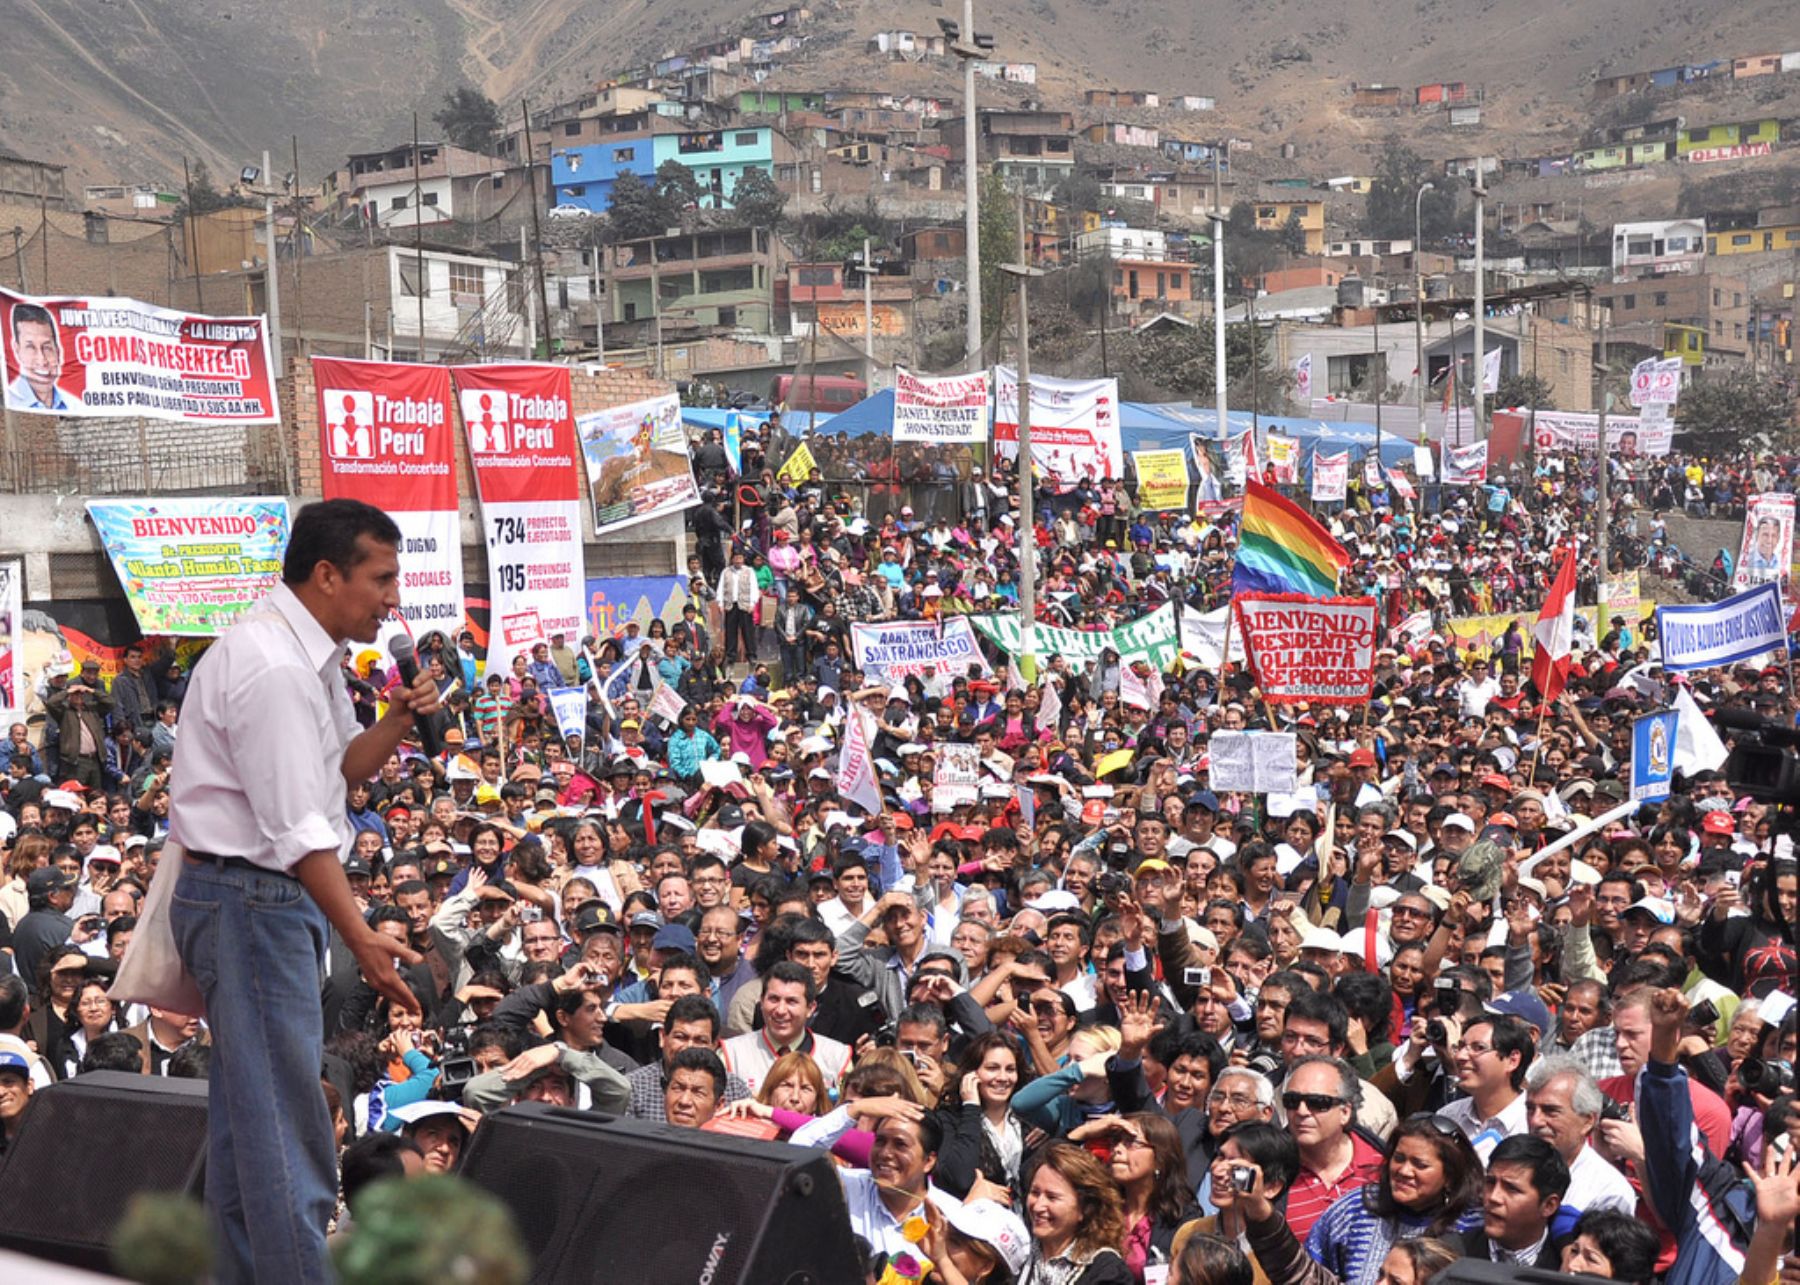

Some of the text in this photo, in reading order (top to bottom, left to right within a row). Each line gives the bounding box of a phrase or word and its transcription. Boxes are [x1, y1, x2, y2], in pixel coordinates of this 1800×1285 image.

[1692, 143, 1770, 162] OLLANTA
[60, 309, 98, 327] JUNTA
[78, 334, 147, 366] COMAS
[101, 371, 242, 396] BIENVENIDO SEÑOR PRESIDENTE
[84, 391, 125, 406] OBRAS
[161, 395, 199, 413] LIBERTAD
[199, 398, 206, 413] Y
[207, 400, 227, 414] SUS
[375, 395, 444, 428] Trabaja
[509, 393, 568, 423] Trabaja
[896, 405, 931, 421] DANIEL
[380, 427, 424, 456] Perú
[513, 423, 554, 449] Perú
[331, 459, 450, 475] Transformación Concertada
[532, 454, 572, 467] Concertada
[132, 516, 258, 537] BIENVENIDO
[527, 516, 568, 529] PROYECTOS
[406, 537, 438, 553] DIGNO
[527, 530, 572, 544] EJECUTADOS
[177, 543, 242, 556] PRESIDENTE
[181, 557, 241, 576] Humala
[241, 556, 282, 573] Tasso
[527, 562, 571, 576] PROVINCIAS
[404, 571, 452, 588] SOCIALES
[498, 563, 526, 592] 195
[527, 576, 570, 591] ATENDIDAS
[201, 590, 235, 606] Virgen
[237, 588, 250, 600] de
[424, 603, 458, 619] SOCIAL
[1243, 610, 1372, 648] BIENVENIDO
[1665, 620, 1696, 657] POLVOS
[1697, 620, 1725, 651] AZULES
[865, 637, 969, 663] SAN FRANCISCO
[1261, 651, 1356, 670] OLLANTA
